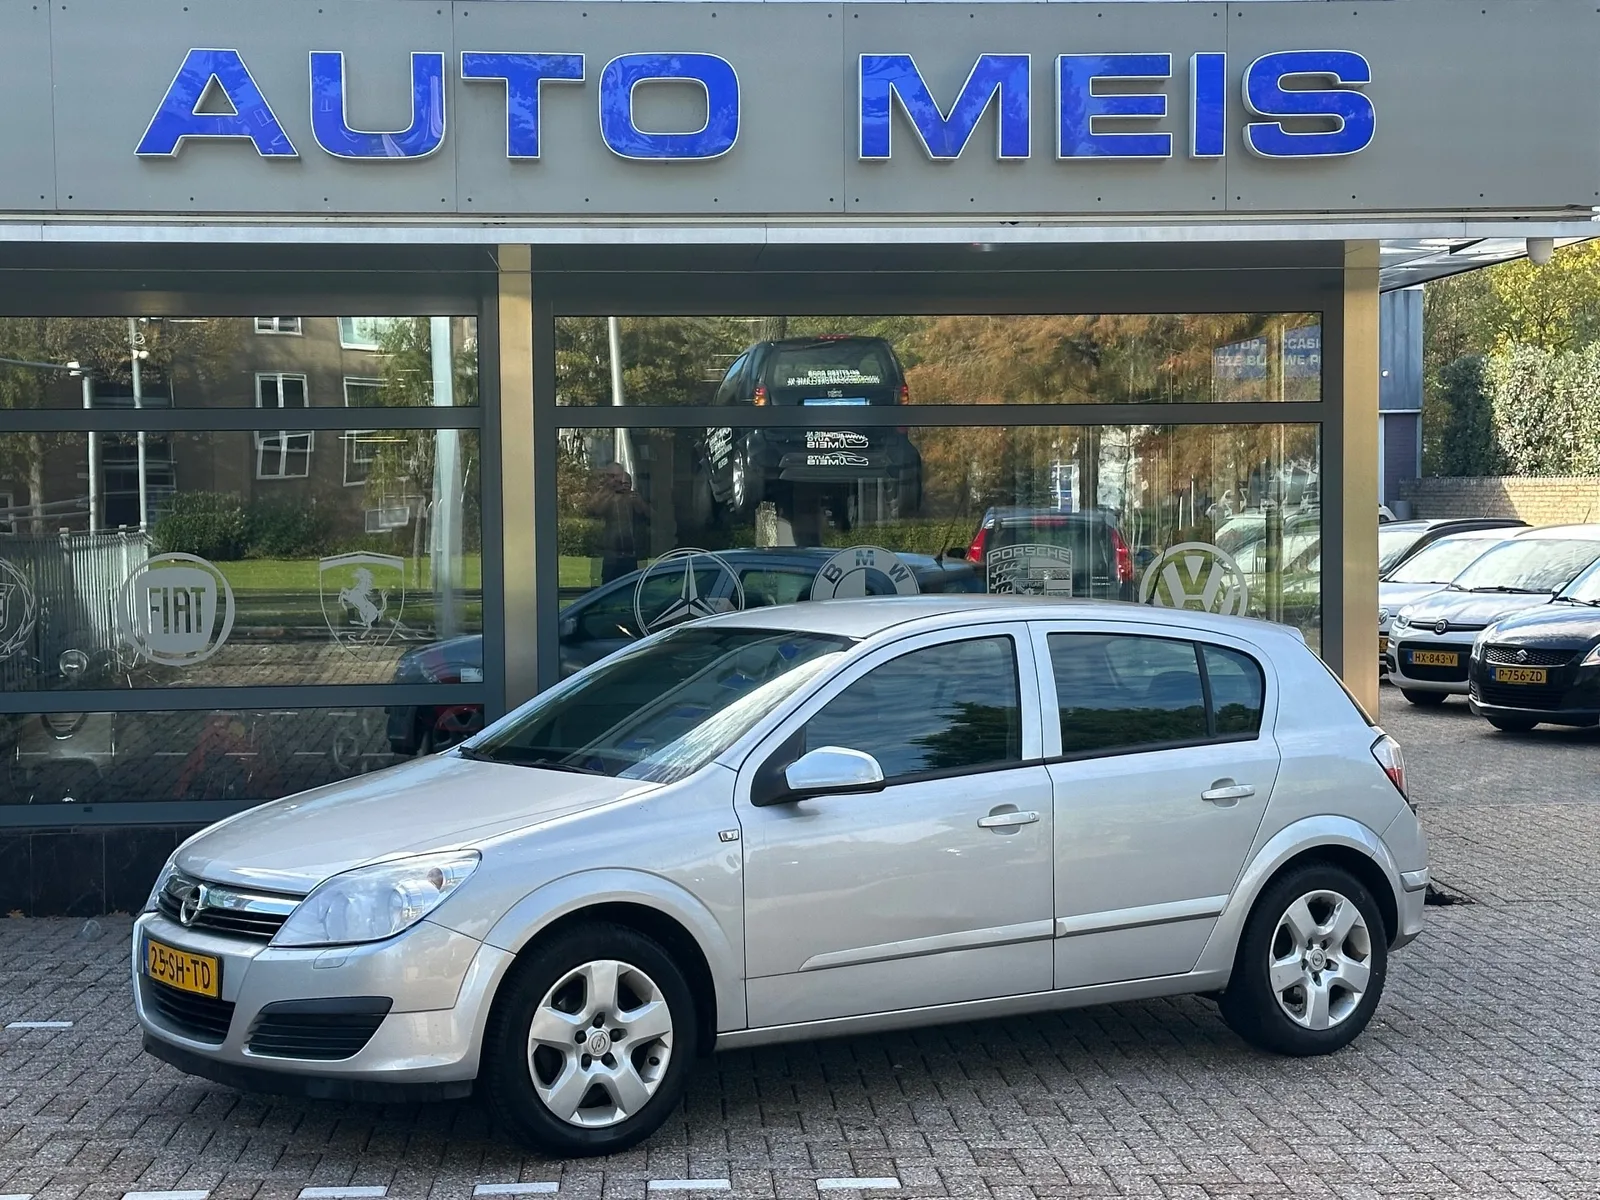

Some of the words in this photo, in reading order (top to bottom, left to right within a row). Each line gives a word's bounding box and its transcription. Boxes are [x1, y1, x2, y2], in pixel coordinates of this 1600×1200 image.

[134, 47, 740, 160] AUTO
[857, 49, 1377, 161] MEIS
[822, 550, 910, 585] BMW
[990, 546, 1070, 562] PORSCHE
[147, 586, 206, 635] FIAT
[1414, 652, 1455, 664] HX-843-V
[1498, 669, 1543, 682] P-756-ZD
[151, 946, 211, 989] 25-SH-TD
